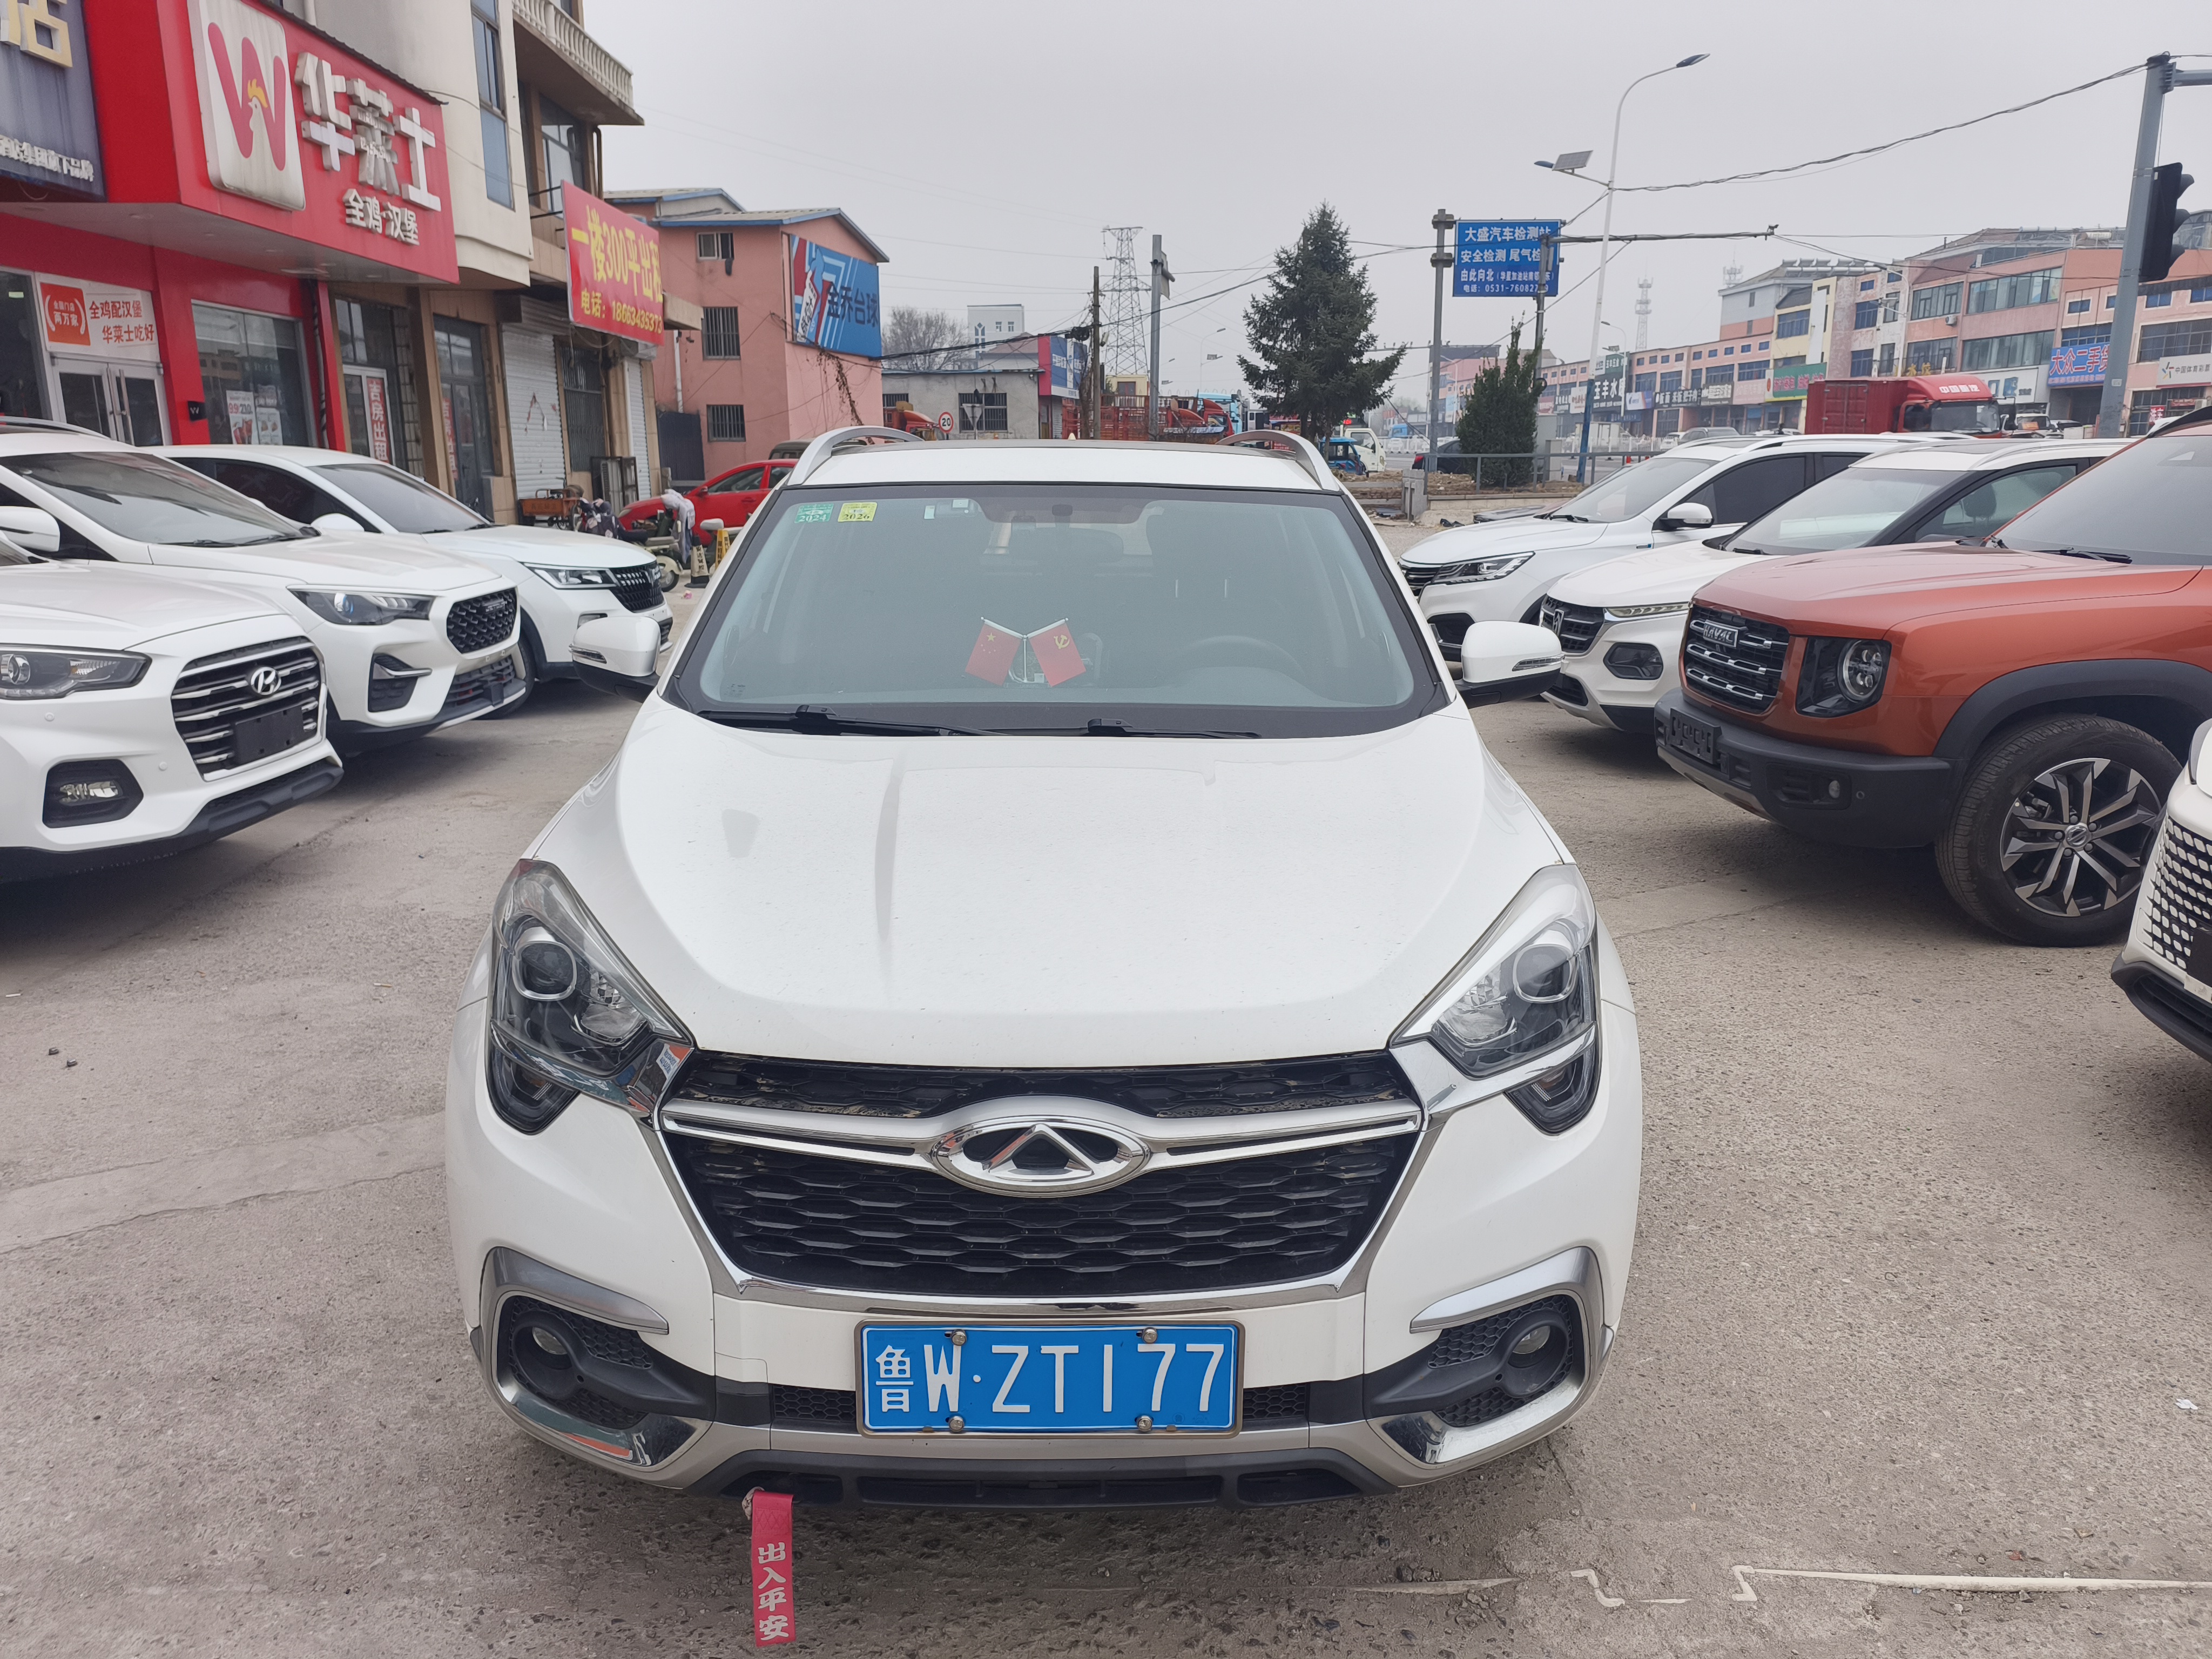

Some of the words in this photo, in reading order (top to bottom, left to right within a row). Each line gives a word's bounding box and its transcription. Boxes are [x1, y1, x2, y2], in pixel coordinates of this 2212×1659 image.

[294, 52, 442, 212] 华莱士
[1465, 226, 1551, 242] 大盛汽车检测站
[571, 204, 663, 303] 一楼300平出租
[1461, 249, 1507, 263] 安全检测
[1509, 248, 1541, 262] 尾气检
[53, 311, 79, 326] 两万家
[89, 300, 143, 320] 全鸡配汉堡
[102, 323, 154, 343] 华莱士吃好
[942, 417, 951, 427] 20
[799, 514, 827, 522] 2024
[1703, 625, 1733, 643] HAVAL
[758, 1542, 789, 1641] 出入平安
